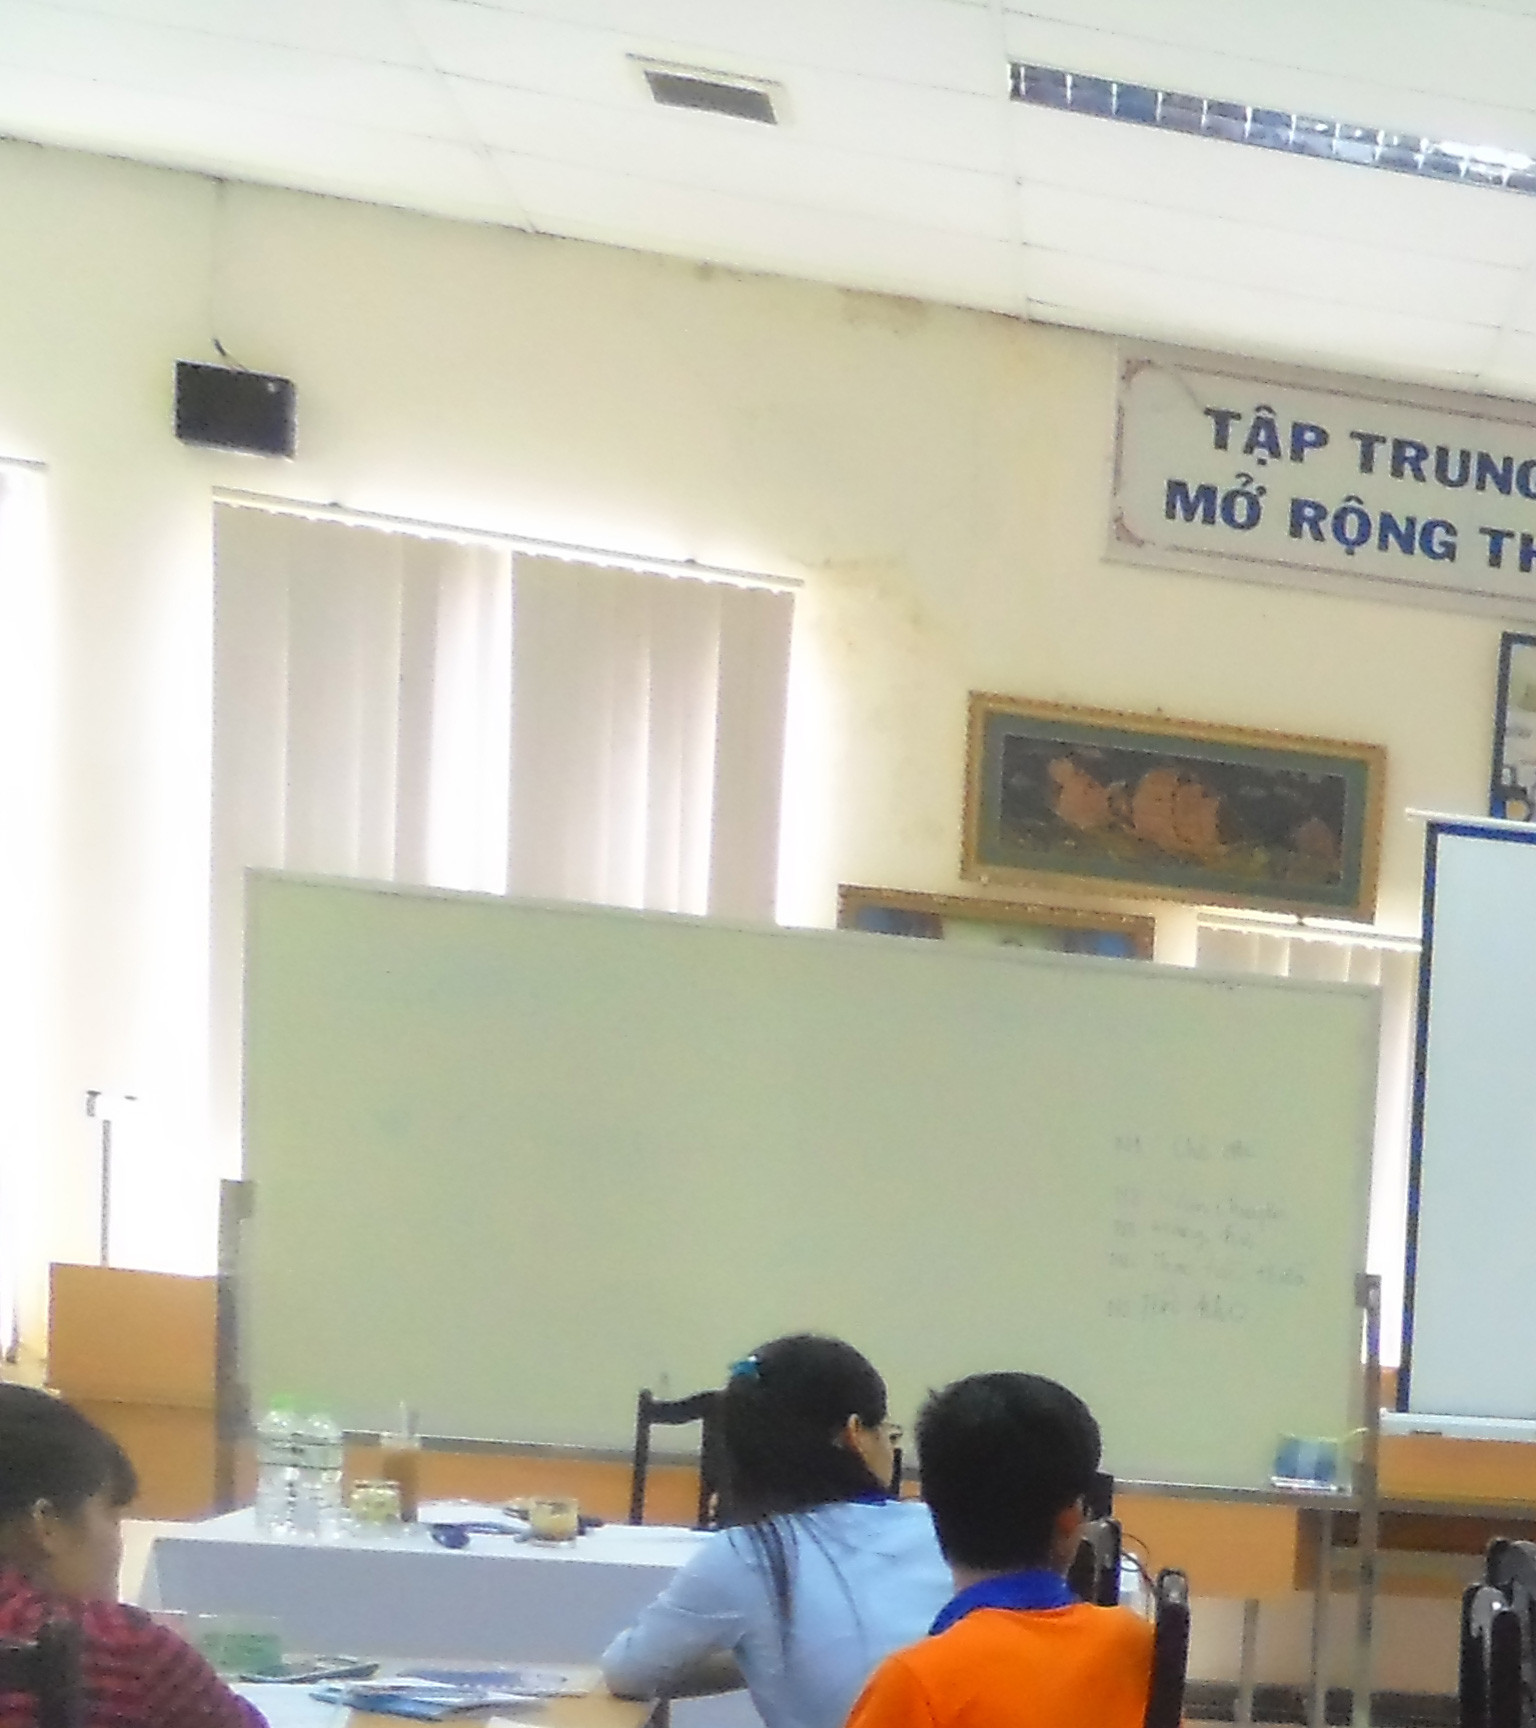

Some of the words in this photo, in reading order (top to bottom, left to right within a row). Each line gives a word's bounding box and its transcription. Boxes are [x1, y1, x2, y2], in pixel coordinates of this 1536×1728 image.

[1204, 405, 1329, 465] TẬP
[1164, 472, 1266, 531] MỞ
[1289, 495, 1458, 563] RỘNG
